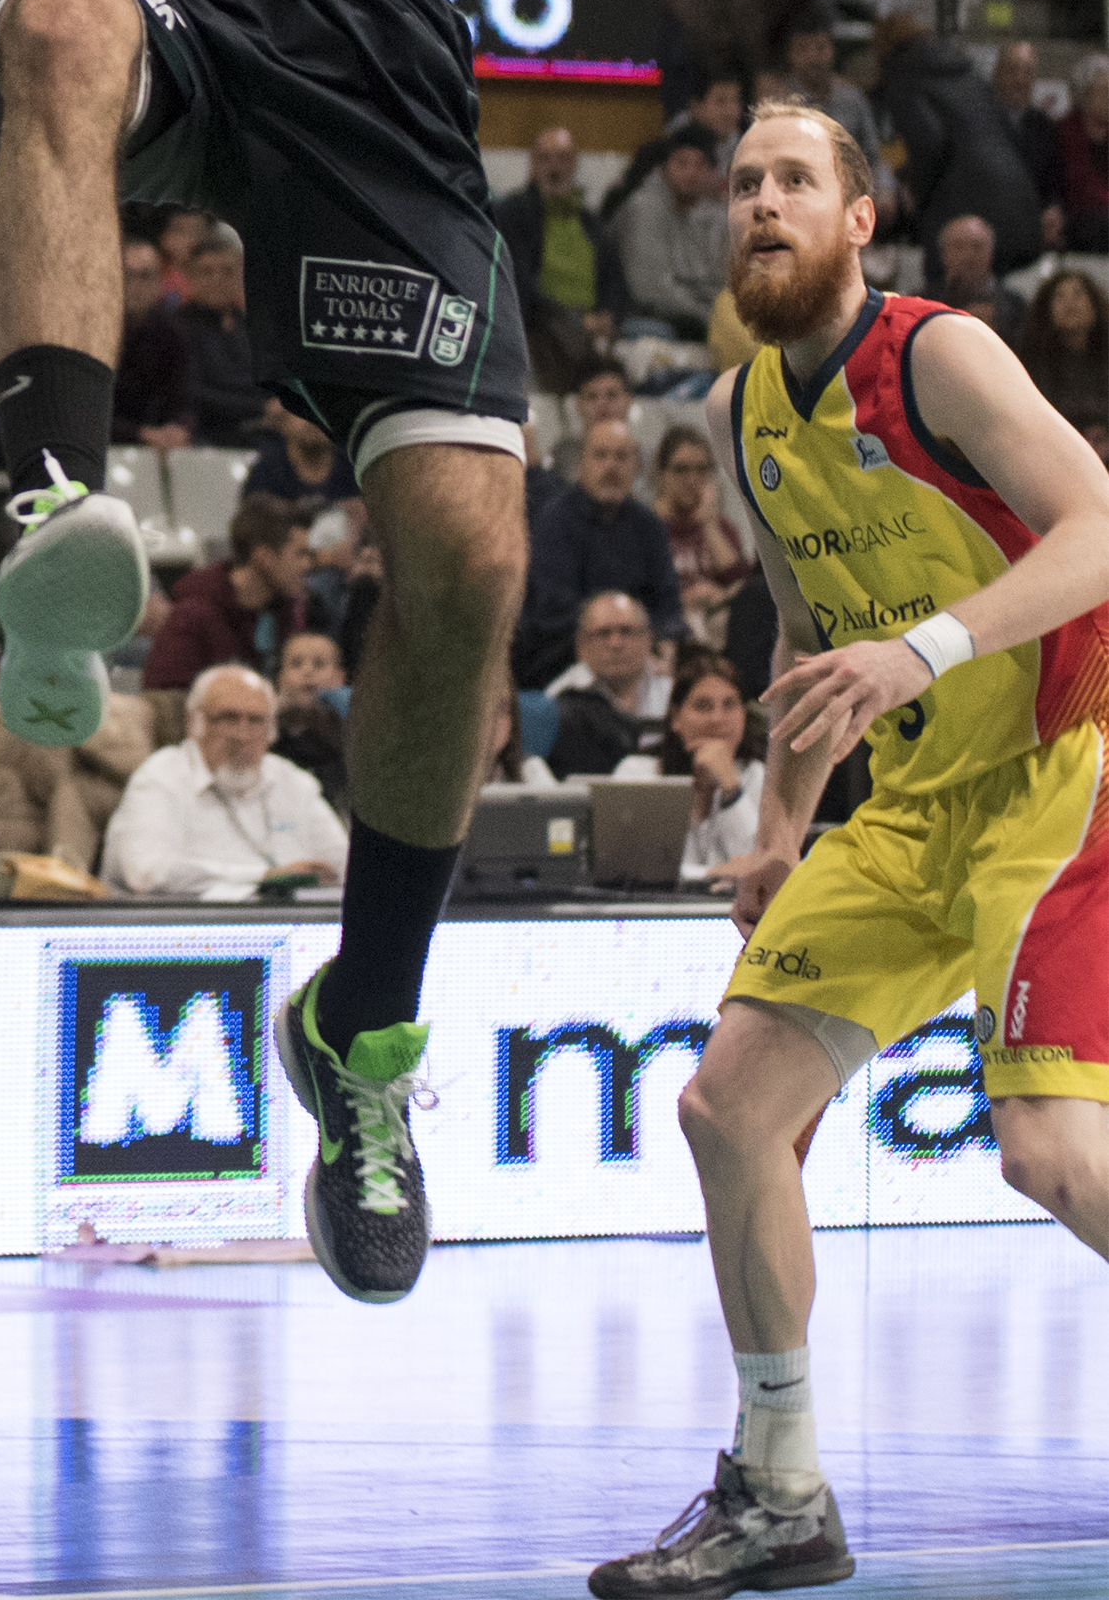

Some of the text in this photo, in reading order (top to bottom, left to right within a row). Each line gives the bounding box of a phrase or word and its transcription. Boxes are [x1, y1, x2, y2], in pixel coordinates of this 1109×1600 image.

[315, 271, 421, 301] ENRIQUE
[841, 593, 937, 632] Andorra
[742, 946, 822, 981] andia
[992, 1045, 1073, 1065] TELECOM
